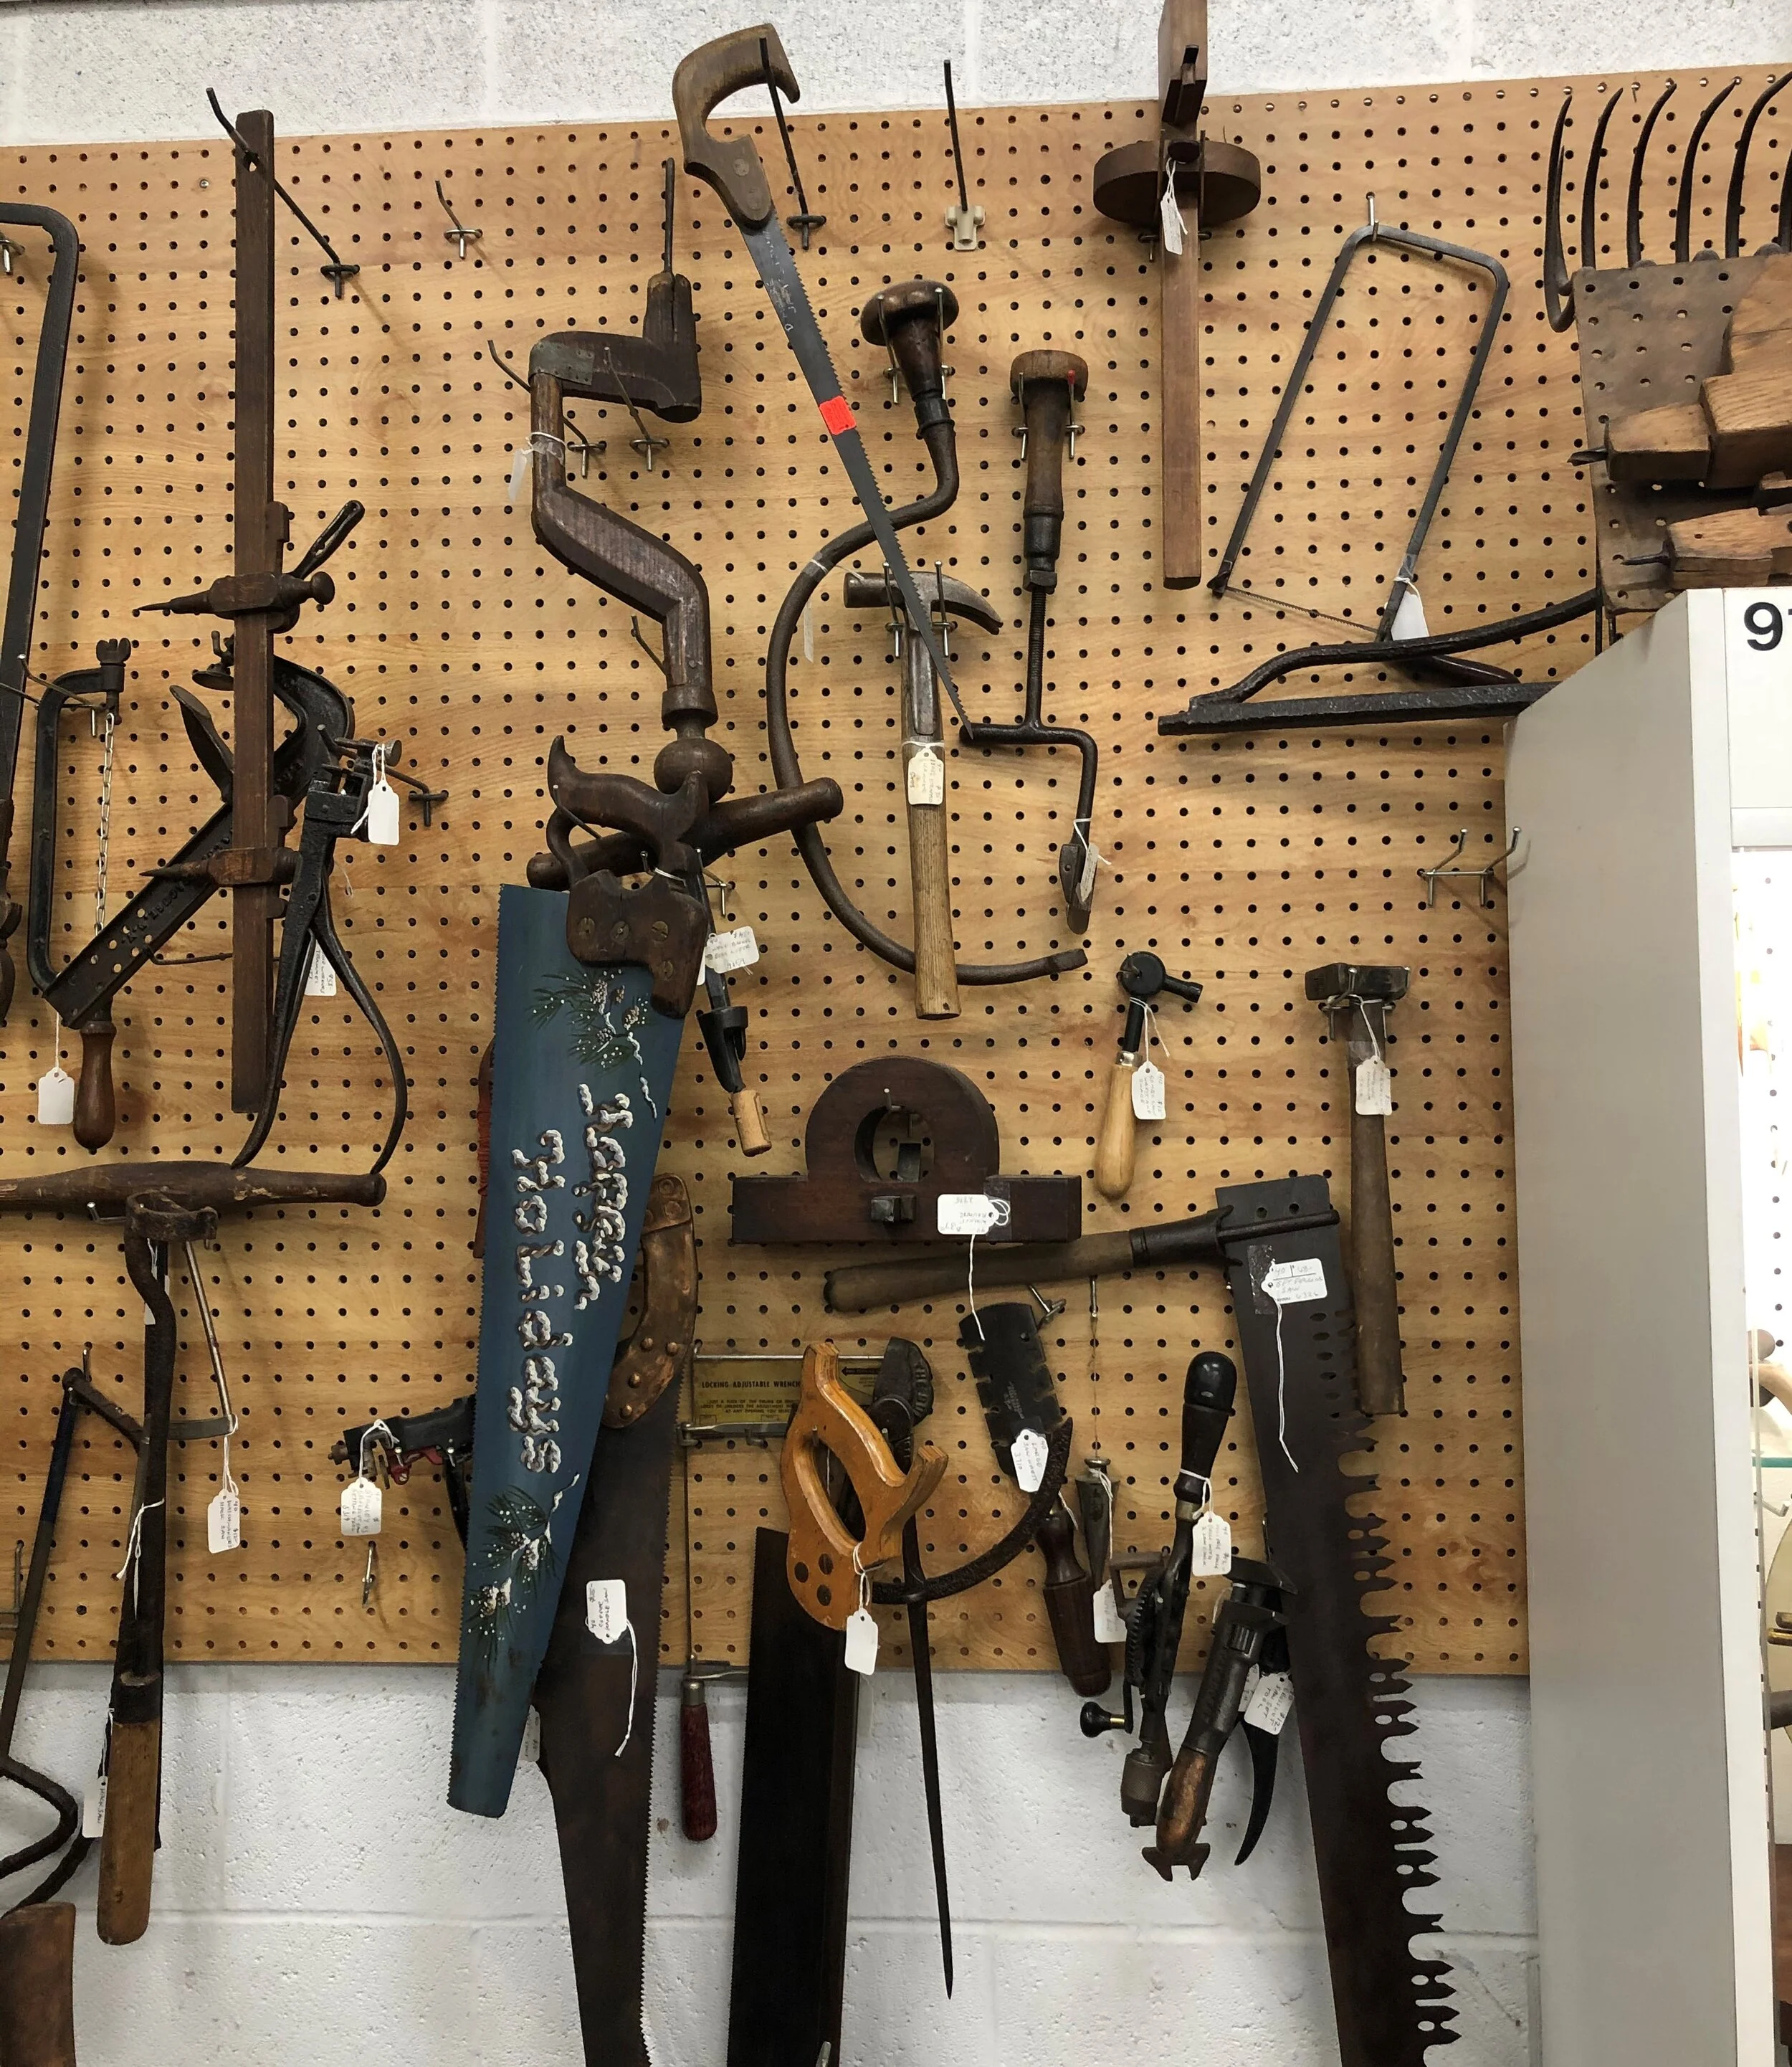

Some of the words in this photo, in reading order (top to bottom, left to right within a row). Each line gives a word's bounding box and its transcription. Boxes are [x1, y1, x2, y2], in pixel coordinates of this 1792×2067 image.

[1744, 602, 1792, 652] 9
[573, 1083, 634, 1311] Happy
[702, 1380, 729, 1389] LOCKING
[733, 1380, 770, 1389] ADJUSTABLE
[1031, 1443, 1043, 1468] LARGE
[1257, 1687, 1272, 1709] TOOL
